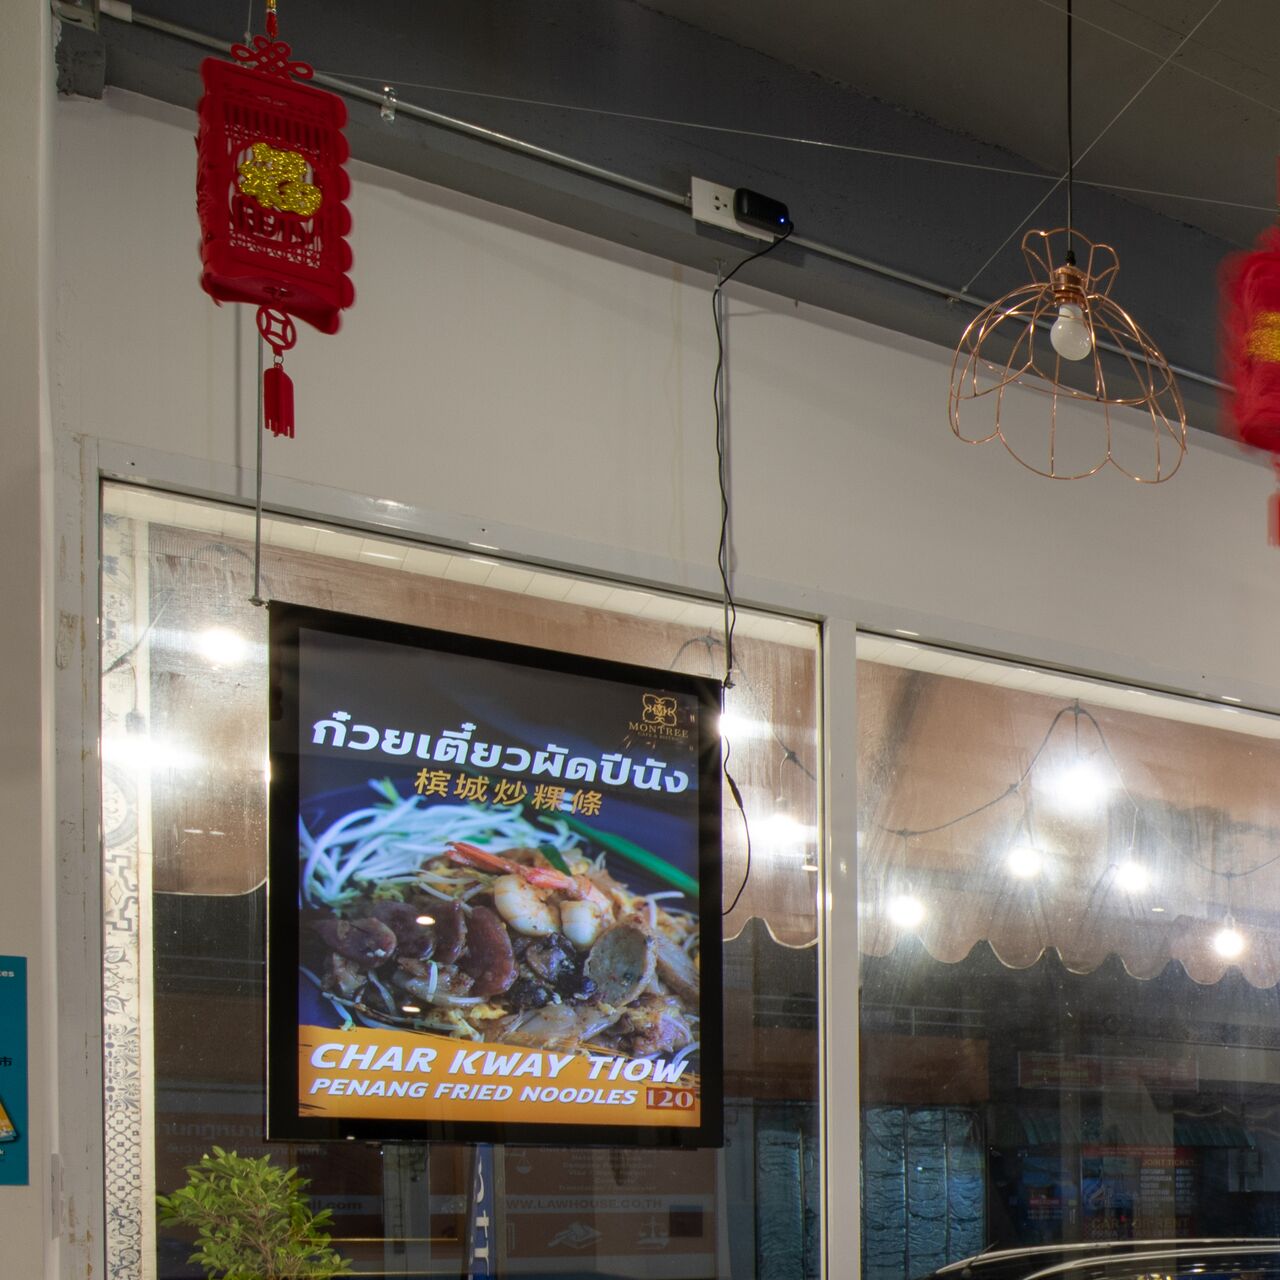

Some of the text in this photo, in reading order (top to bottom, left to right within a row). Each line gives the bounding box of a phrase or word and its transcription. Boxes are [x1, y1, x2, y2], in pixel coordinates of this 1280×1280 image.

[628, 722, 688, 737] MONTREE
[312, 710, 689, 794] ก๋วยเตี๋ยวผัดปีนัง
[310, 1043, 688, 1084] CHAR KWAY TIOW
[310, 1078, 693, 1109] PENANG FRIED NOODLES 120
[506, 1199, 662, 1210] WW.LAWHOUSE.CO.TH
